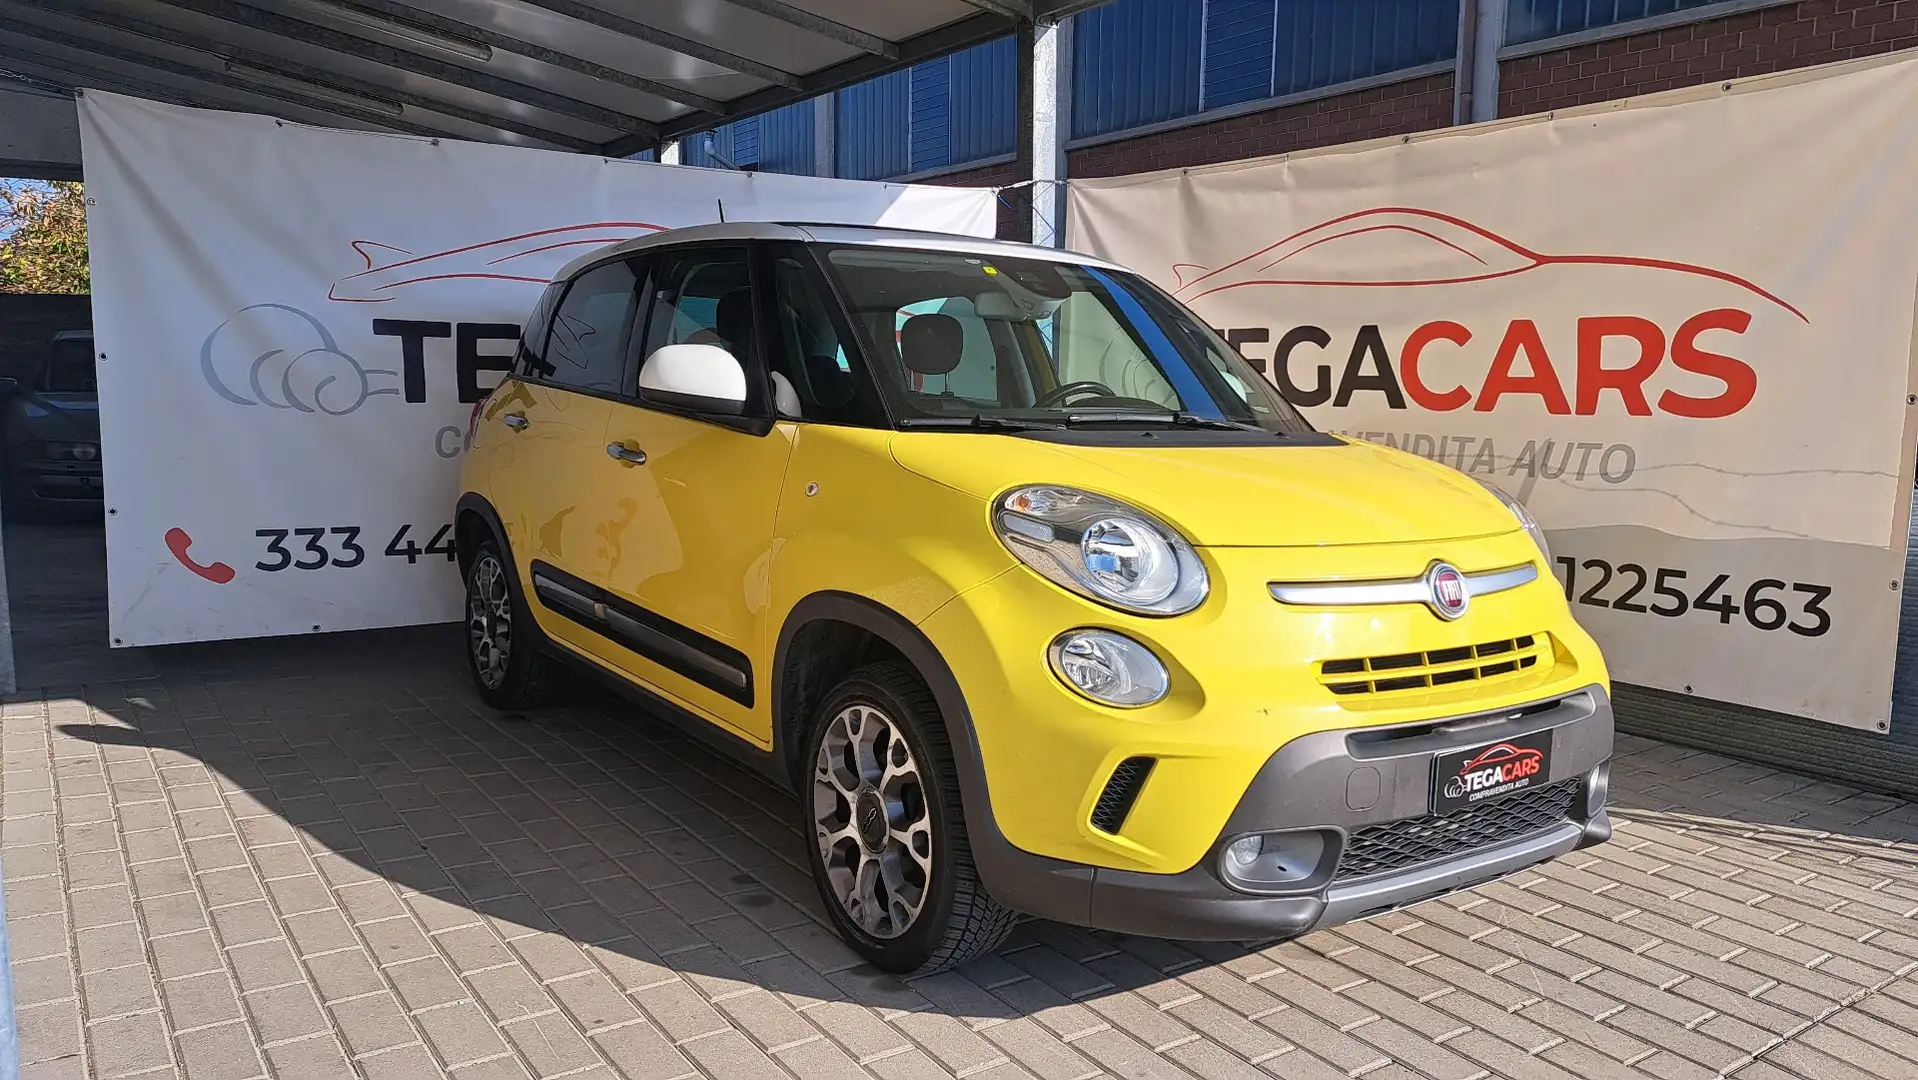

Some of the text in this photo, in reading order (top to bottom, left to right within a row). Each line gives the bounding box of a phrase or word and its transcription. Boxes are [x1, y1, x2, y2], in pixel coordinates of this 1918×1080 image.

[1214, 308, 1758, 418] EGACARS
[1341, 429, 1636, 484] NDITA AUTO
[254, 526, 365, 572] 333
[1556, 555, 1832, 637] 1225463
[1464, 756, 1540, 792] TEGACARS
[1469, 778, 1529, 802] COMPRAVENDITA AUTO
